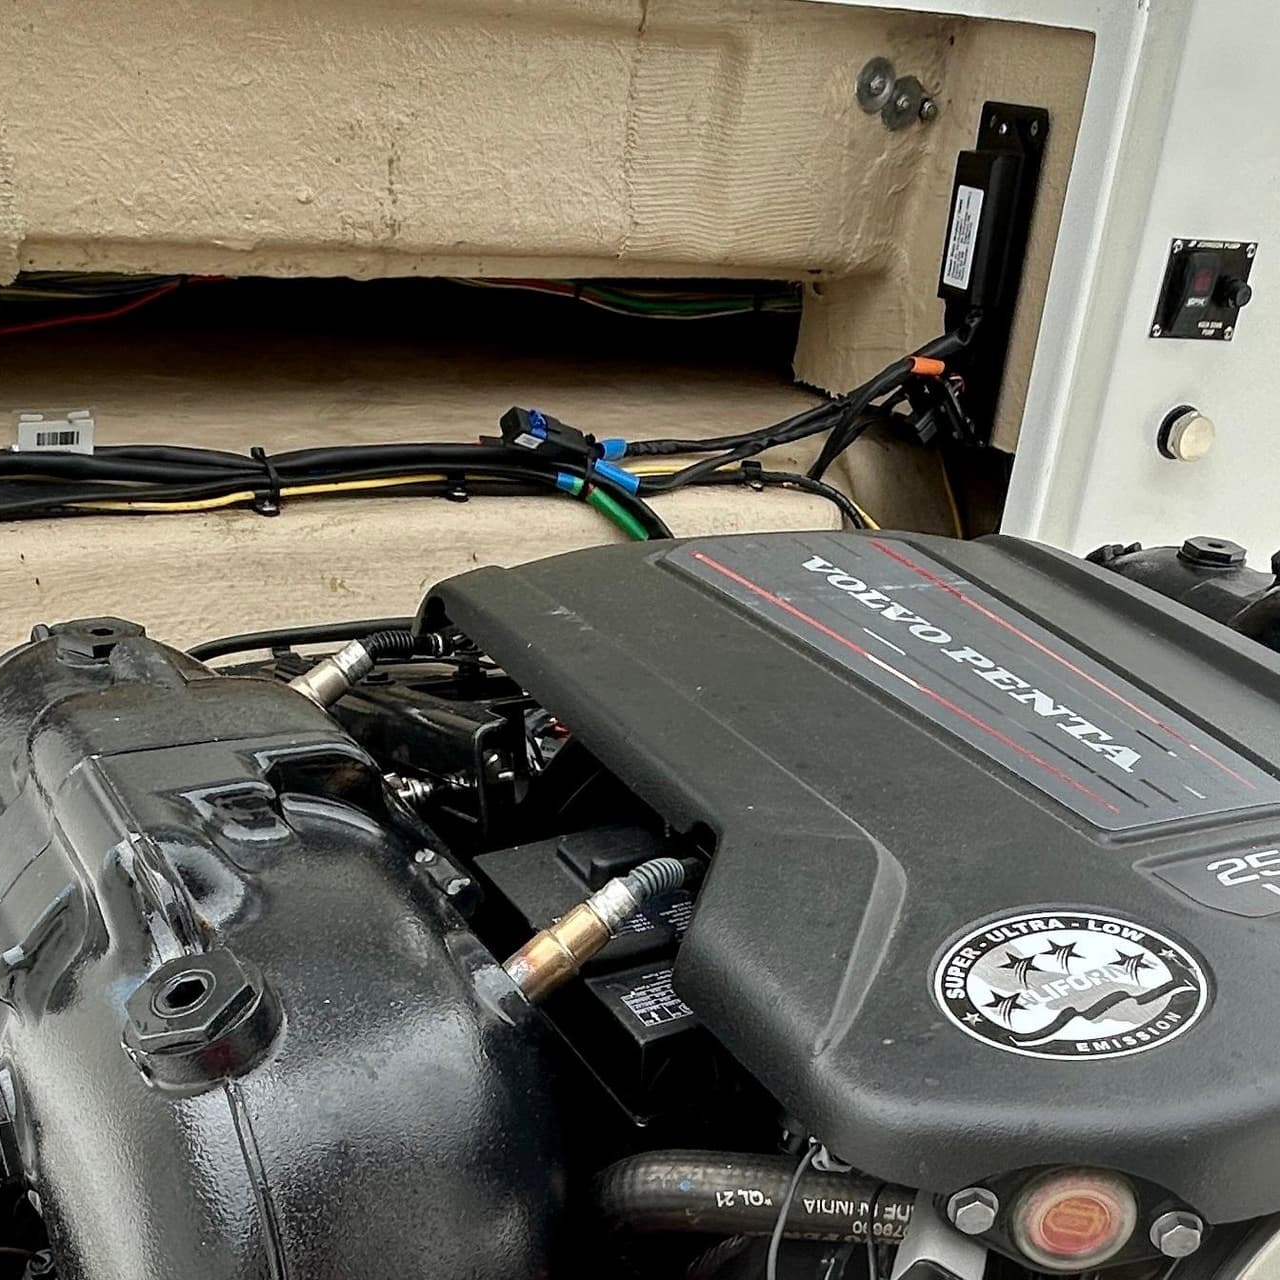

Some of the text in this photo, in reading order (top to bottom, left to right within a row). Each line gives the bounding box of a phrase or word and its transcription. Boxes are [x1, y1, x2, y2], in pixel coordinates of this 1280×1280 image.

[802, 555, 1142, 773] VOLVO PENTA
[945, 918, 1145, 1000] SUPER ULTRA LOW
[1076, 1012, 1181, 1053] EMISSION
[714, 1190, 735, 1208] 21
[803, 1197, 854, 1215] INDIA
